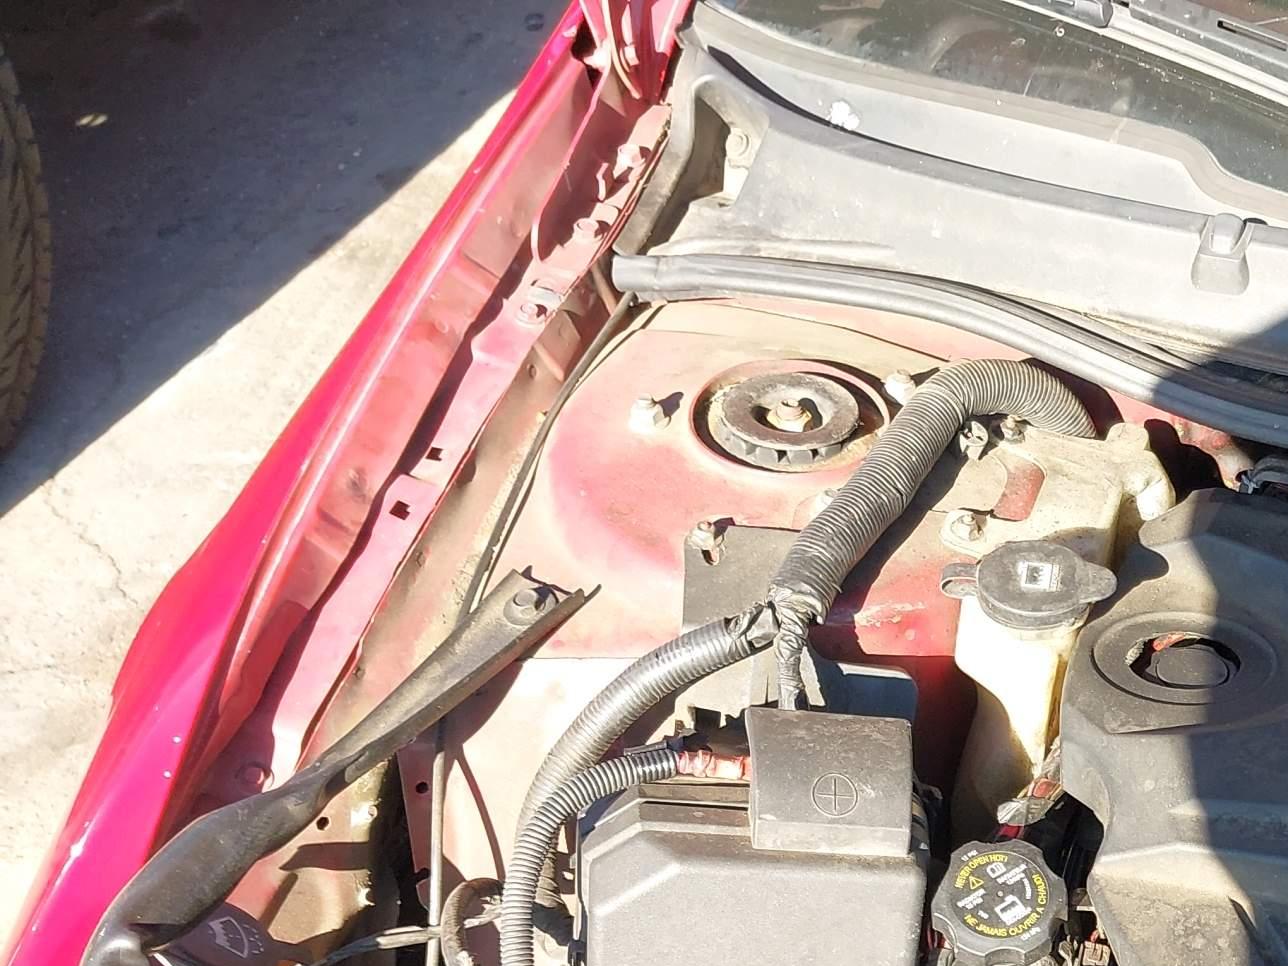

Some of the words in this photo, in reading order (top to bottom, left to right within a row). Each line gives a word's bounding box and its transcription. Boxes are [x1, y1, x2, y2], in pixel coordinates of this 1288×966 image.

[955, 862, 972, 888] NEVER
[970, 855, 989, 869] OPEN
[988, 854, 1008, 863] HOT!
[964, 915, 976, 926] NE
[976, 923, 1007, 936] JAMAIS
[1009, 913, 1039, 935] OUVRIR
[1032, 874, 1047, 904] CHAUD!
